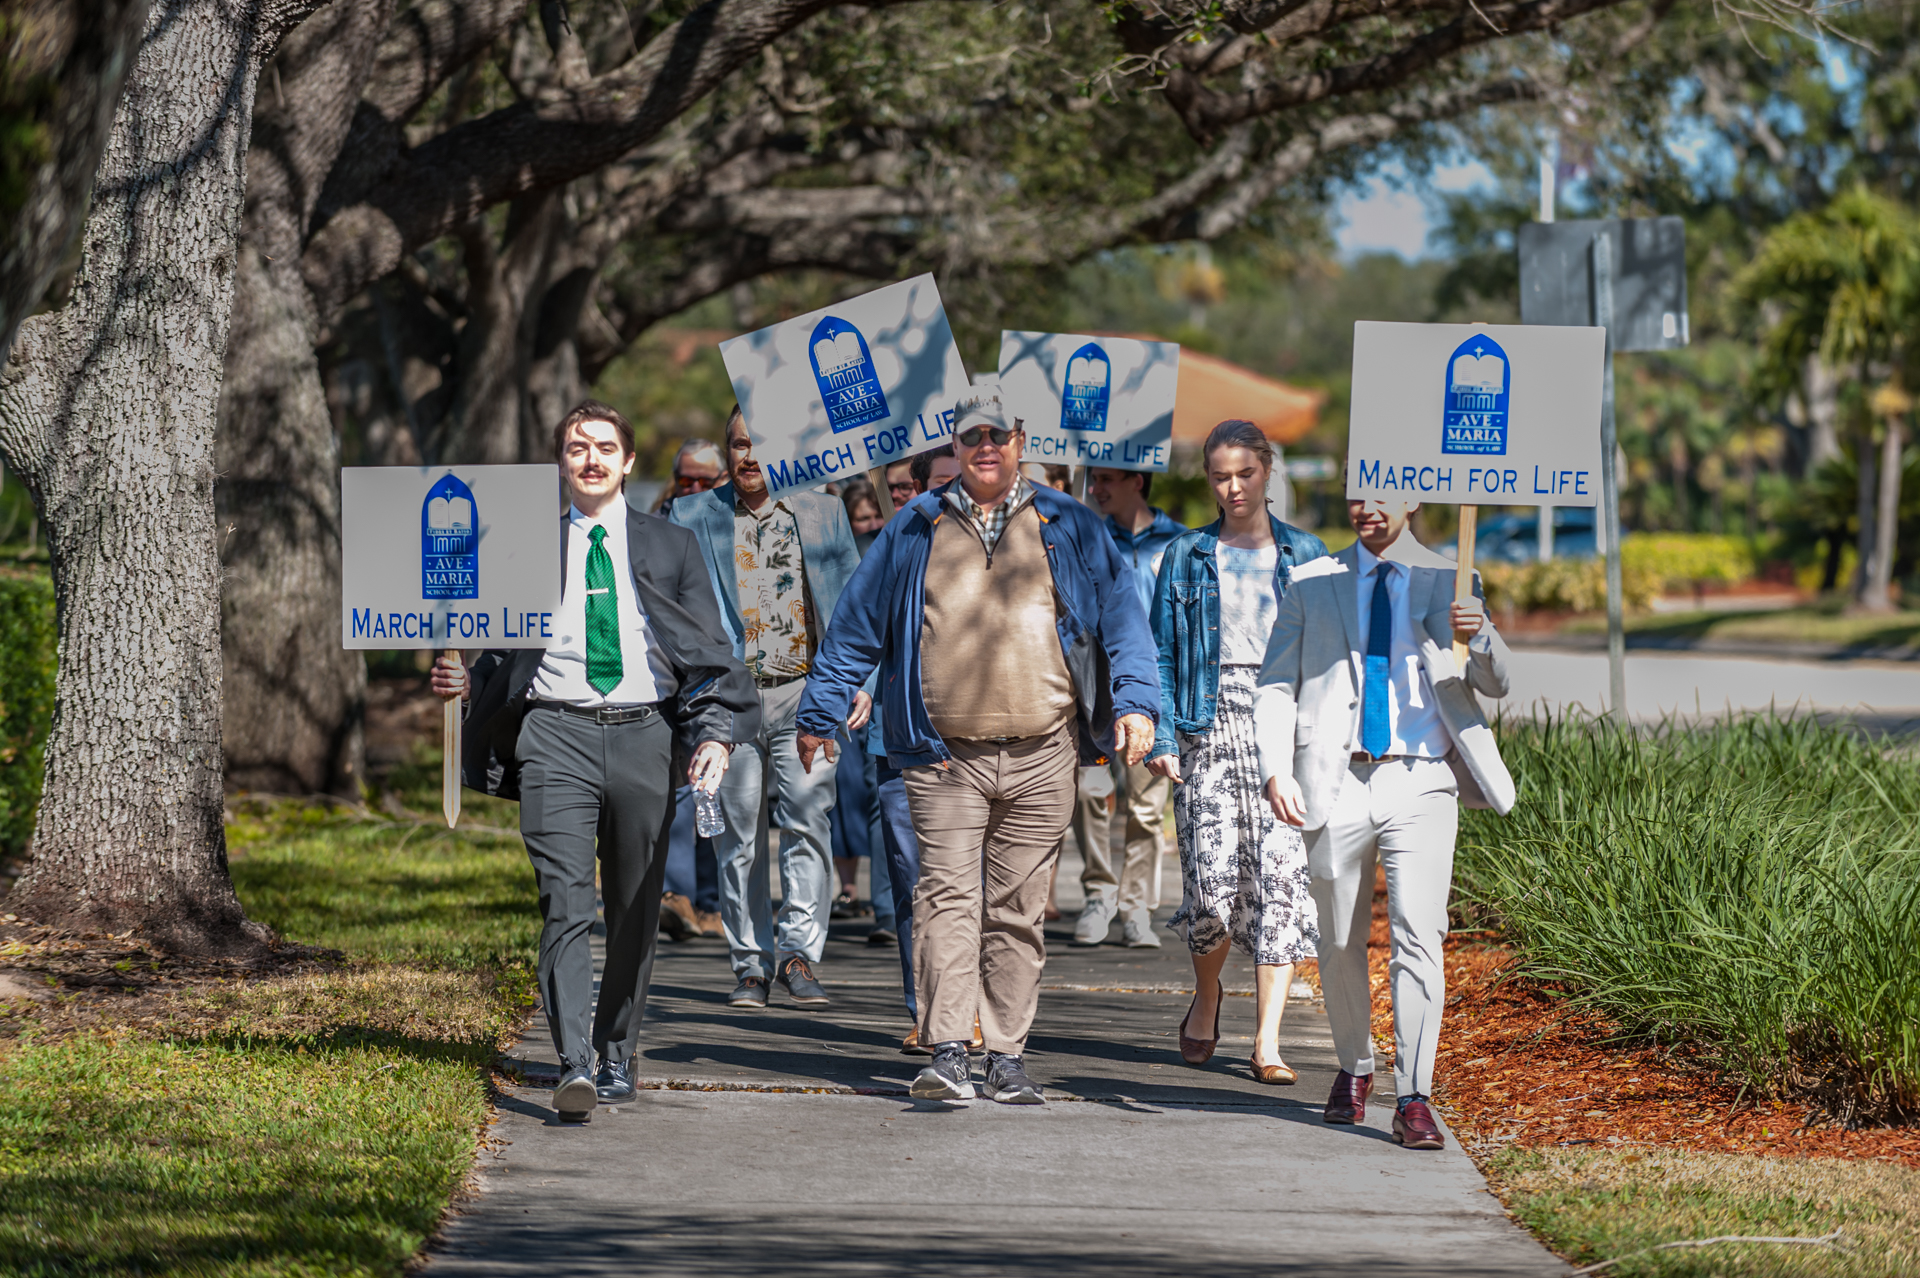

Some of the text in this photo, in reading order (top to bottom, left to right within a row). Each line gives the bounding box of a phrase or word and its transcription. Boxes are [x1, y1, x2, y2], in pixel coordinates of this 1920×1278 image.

[838, 385, 867, 404] AVE
[831, 396, 881, 420] MARIA
[1073, 400, 1097, 410] AVE
[835, 409, 884, 430] SCHOOL of LAW
[1064, 410, 1103, 422] MARIA
[1458, 414, 1492, 427] AVE
[1447, 428, 1501, 442] MARIA
[766, 408, 955, 492] MARCH FOR LIF
[1023, 436, 1164, 466] RCH FOR LIFE
[1359, 459, 1589, 495] MARCH FOR LIFE
[435, 557, 464, 570] AVE
[426, 572, 474, 585] MARIA
[452, 589, 460, 597] of
[352, 607, 553, 639] MARCH FOR LIFE
